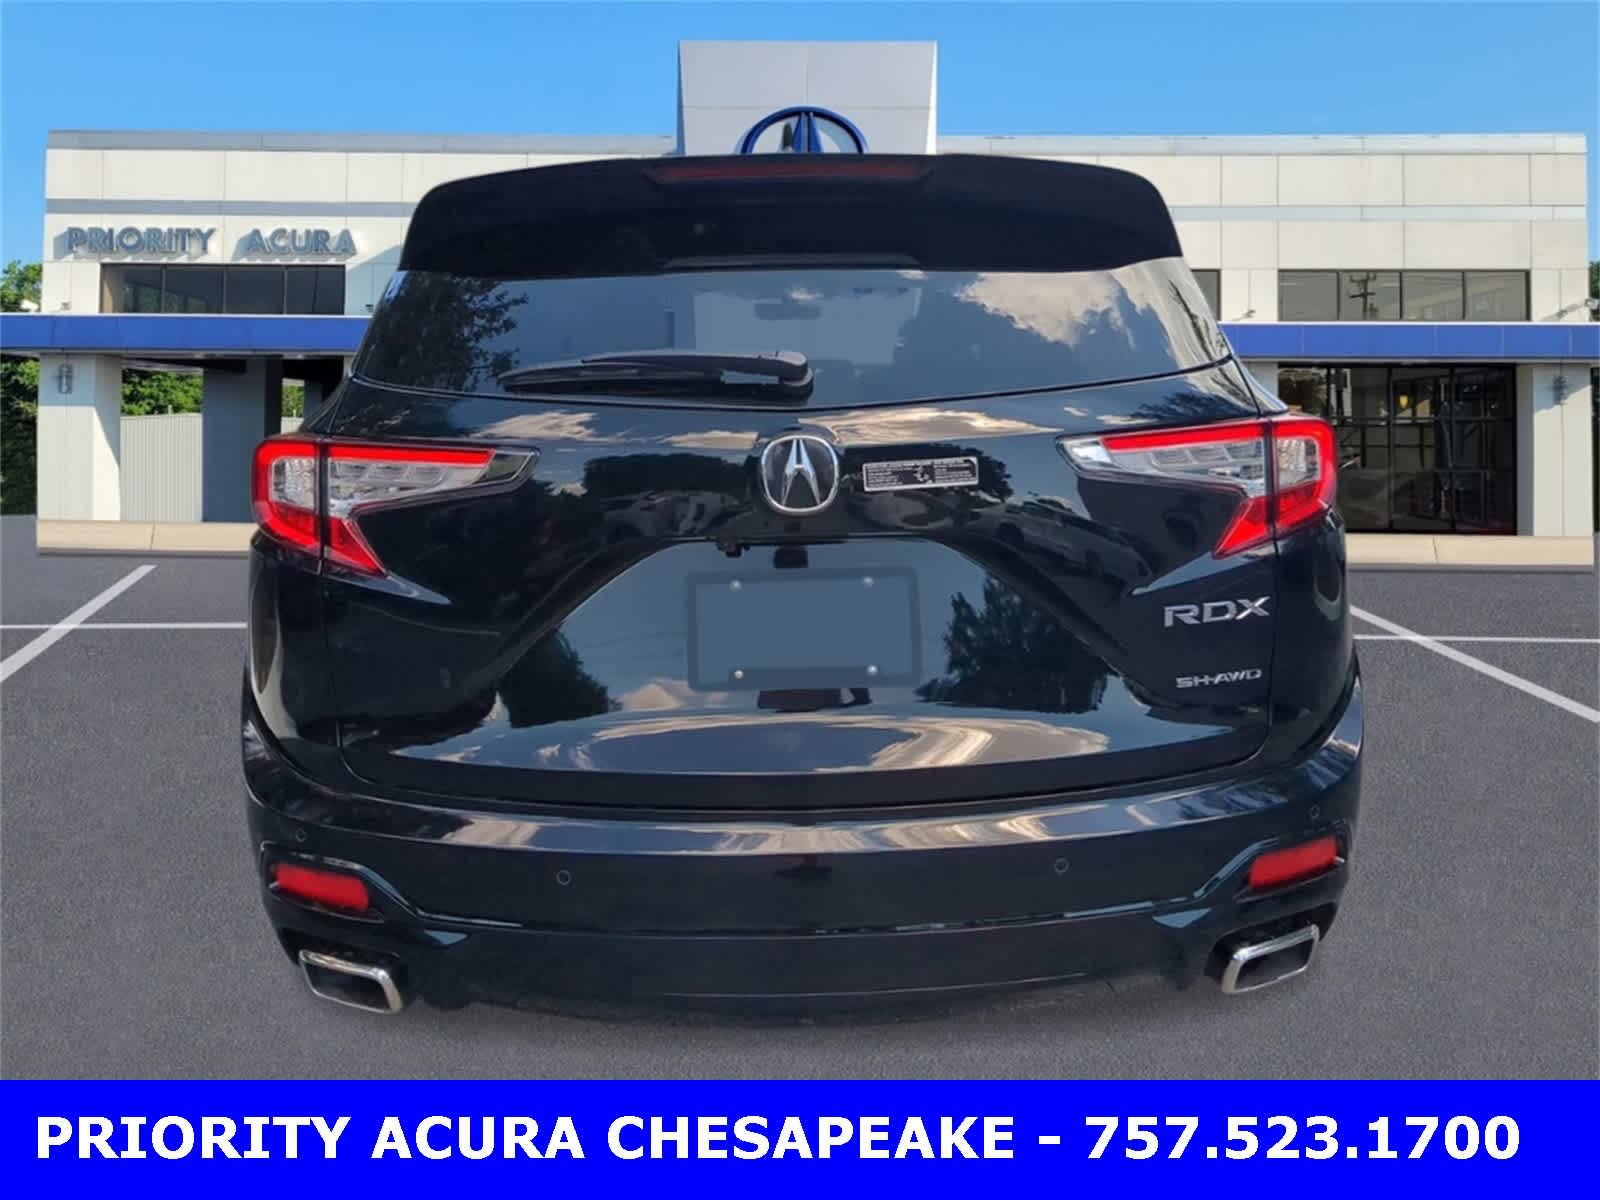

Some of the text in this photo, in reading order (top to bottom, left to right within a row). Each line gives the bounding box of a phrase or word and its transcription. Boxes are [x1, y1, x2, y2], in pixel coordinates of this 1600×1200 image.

[65, 226, 357, 256] PRIORITY ACURA
[1163, 595, 1271, 628] RDX
[1175, 668, 1263, 689] SH-AWD
